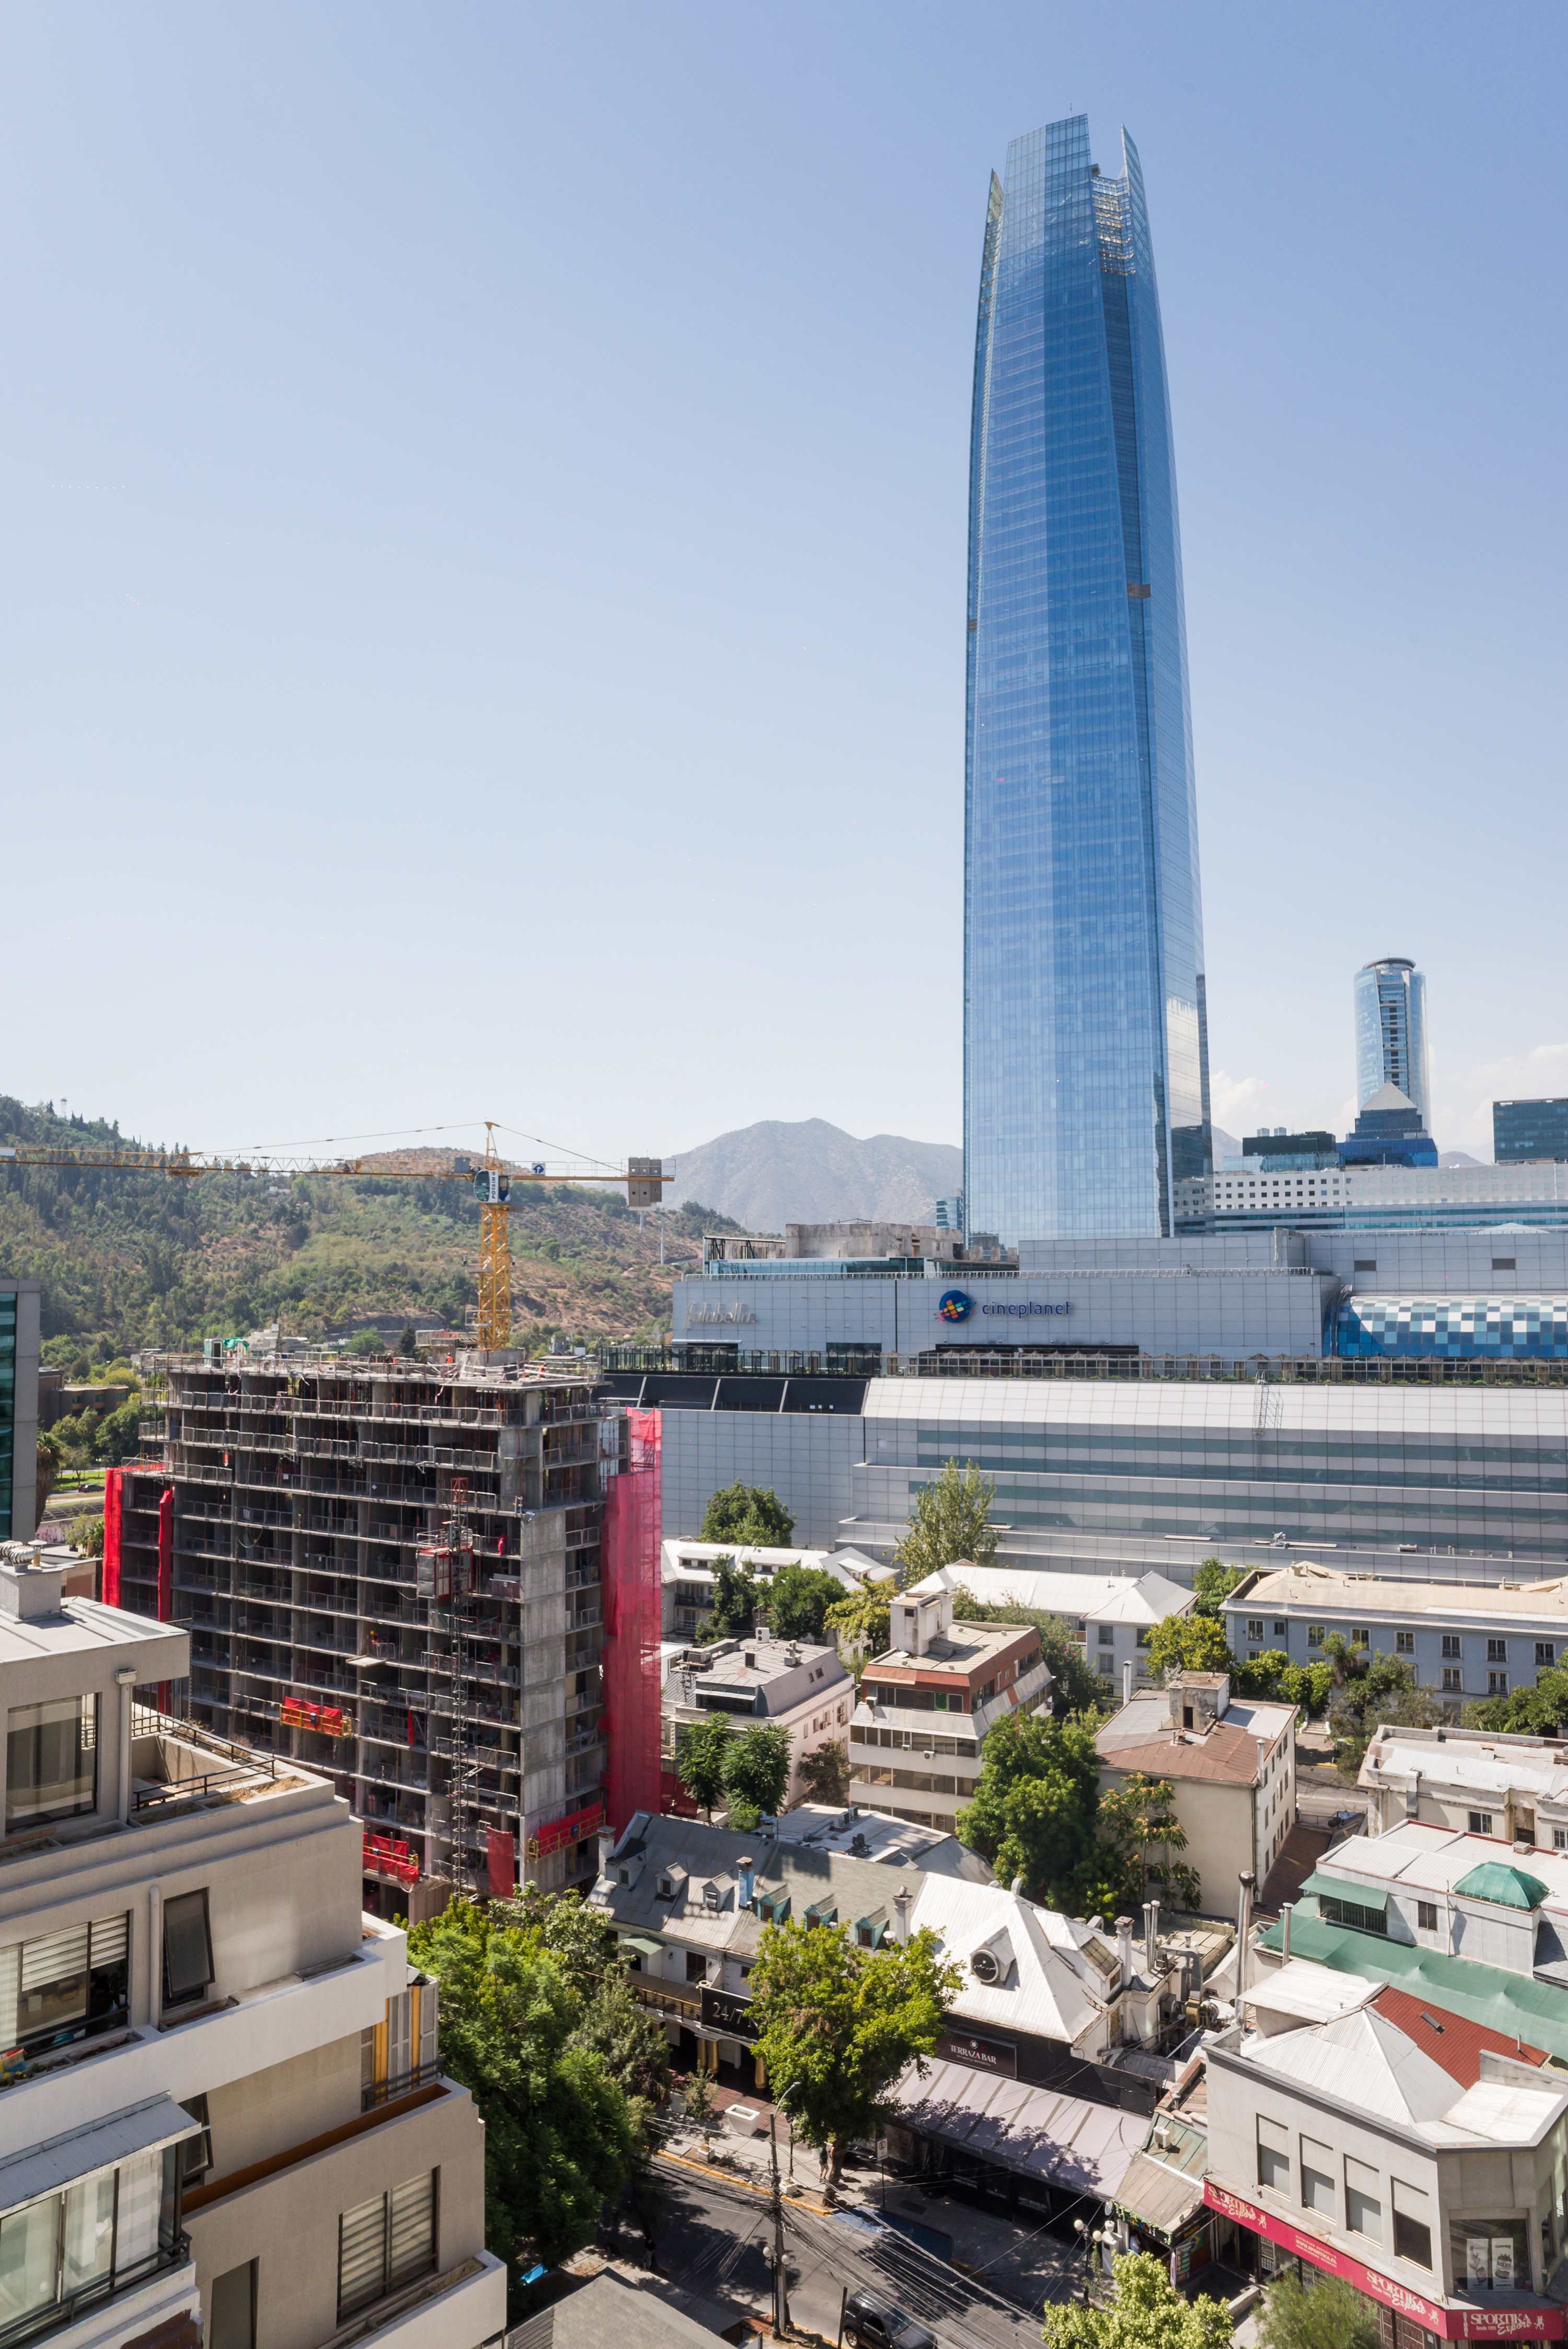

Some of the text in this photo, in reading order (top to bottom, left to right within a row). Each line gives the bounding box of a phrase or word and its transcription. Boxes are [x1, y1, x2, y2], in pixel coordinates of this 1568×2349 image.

[983, 1302, 1071, 1319] cineplanet
[712, 2001, 744, 2024] 24/7
[949, 2044, 981, 2059] TERRAZA
[981, 2053, 997, 2064] BAR
[1208, 2185, 1255, 2214] SORTIKA
[1367, 2270, 1424, 2307] SPORTIKA
[1470, 2313, 1532, 2325] SPORTIKA
